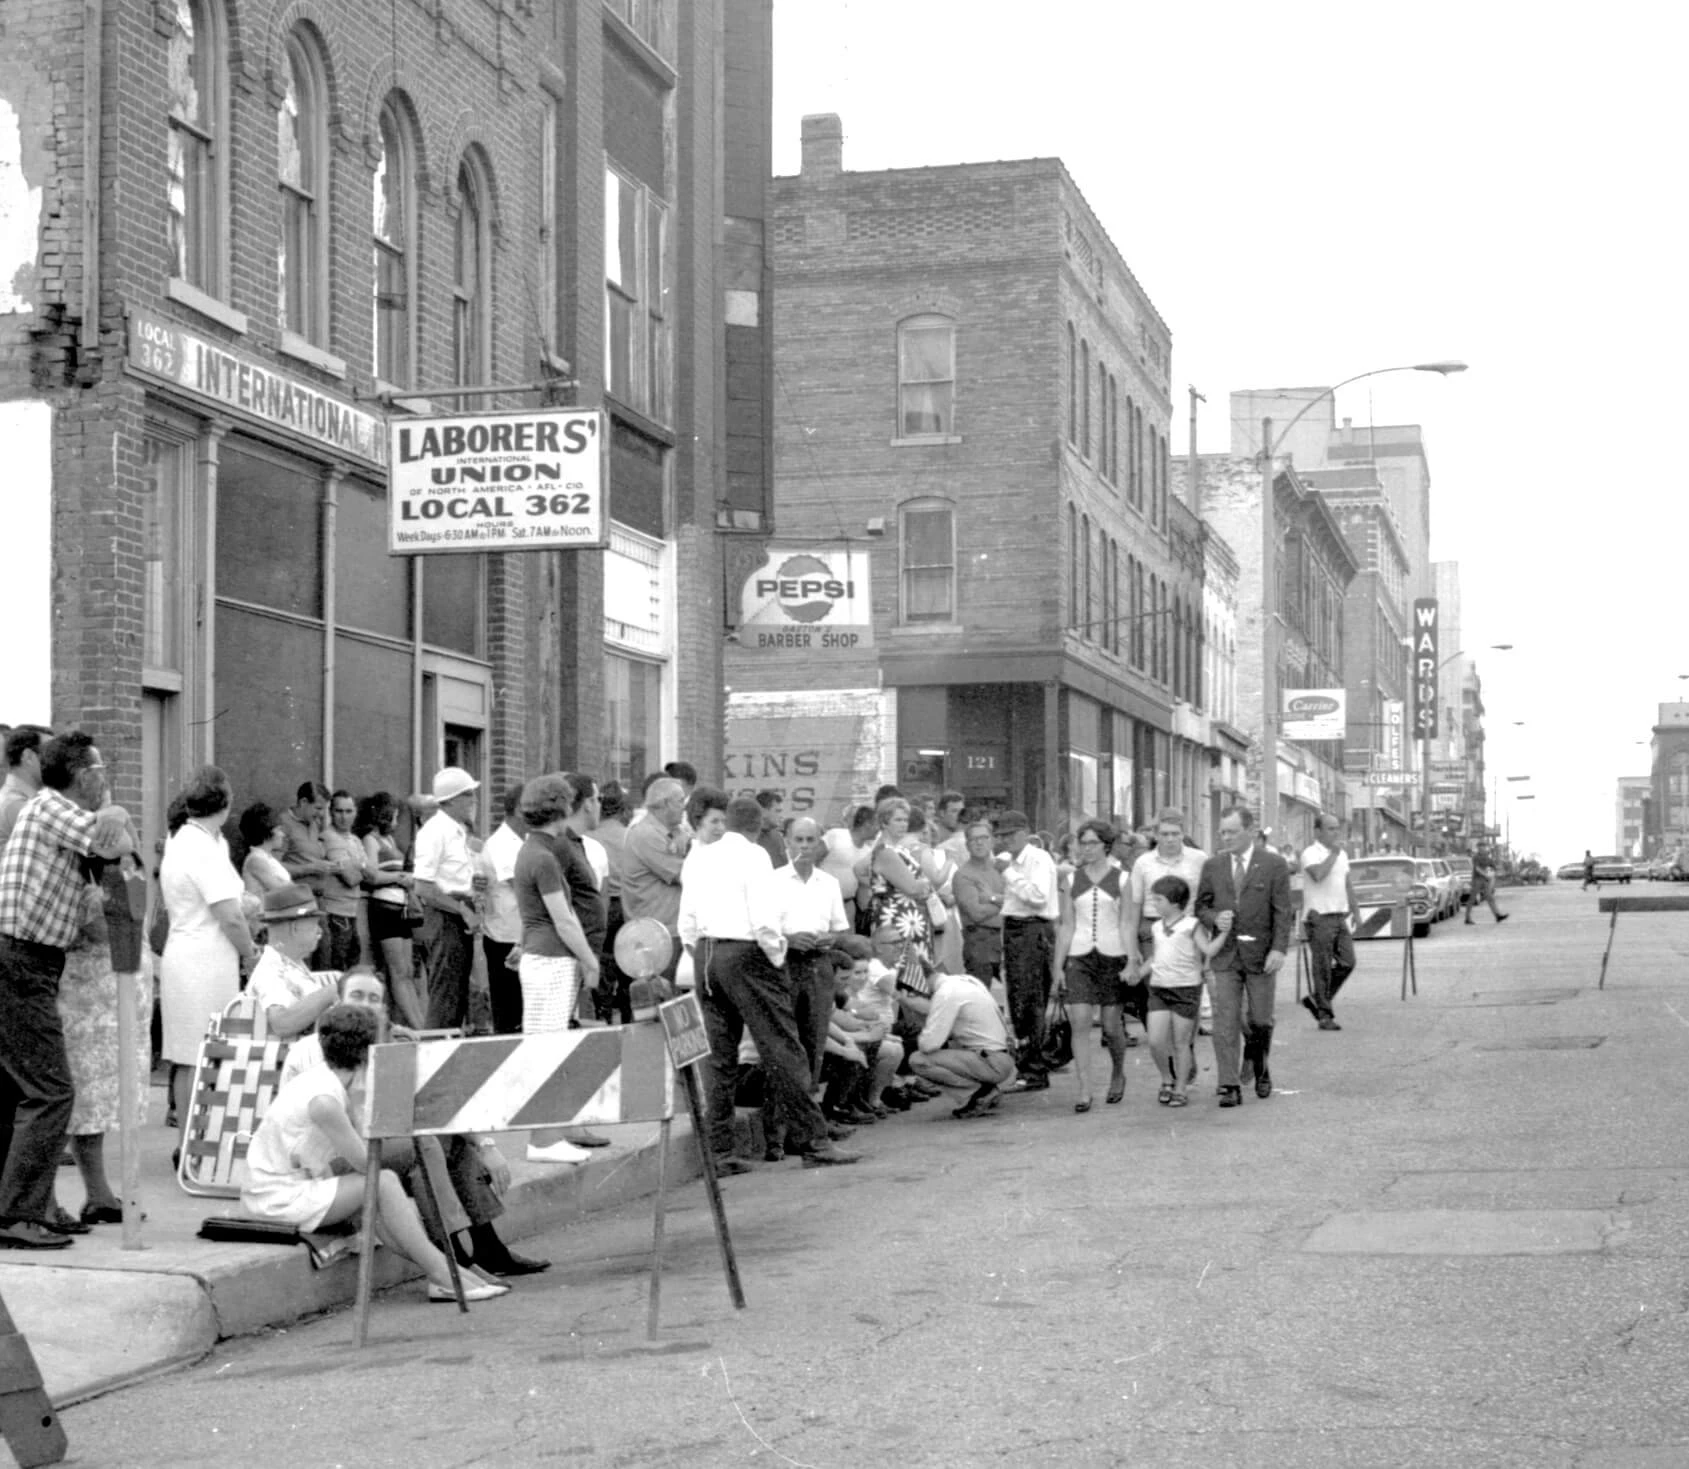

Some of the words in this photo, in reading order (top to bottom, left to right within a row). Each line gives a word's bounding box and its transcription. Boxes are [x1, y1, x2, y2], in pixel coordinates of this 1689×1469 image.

[138, 321, 177, 351] LOCAL
[142, 344, 177, 376] 362
[196, 343, 366, 453] INTERNATIONAL
[399, 418, 596, 463] LABORERS'
[456, 456, 531, 464] INTERNATIONAL
[431, 463, 560, 485] UNION
[428, 485, 466, 495] NORTH
[472, 485, 523, 494] AMERICA
[402, 498, 513, 520] LOCAL
[526, 494, 590, 516] 362
[757, 580, 854, 598] PEPSI
[758, 633, 811, 648] BARBER
[821, 634, 858, 647] SHOP
[1416, 608, 1435, 728] WARDS
[1292, 700, 1334, 712] Carrier
[968, 756, 995, 769] 121
[1370, 774, 1417, 784] CLEANERS
